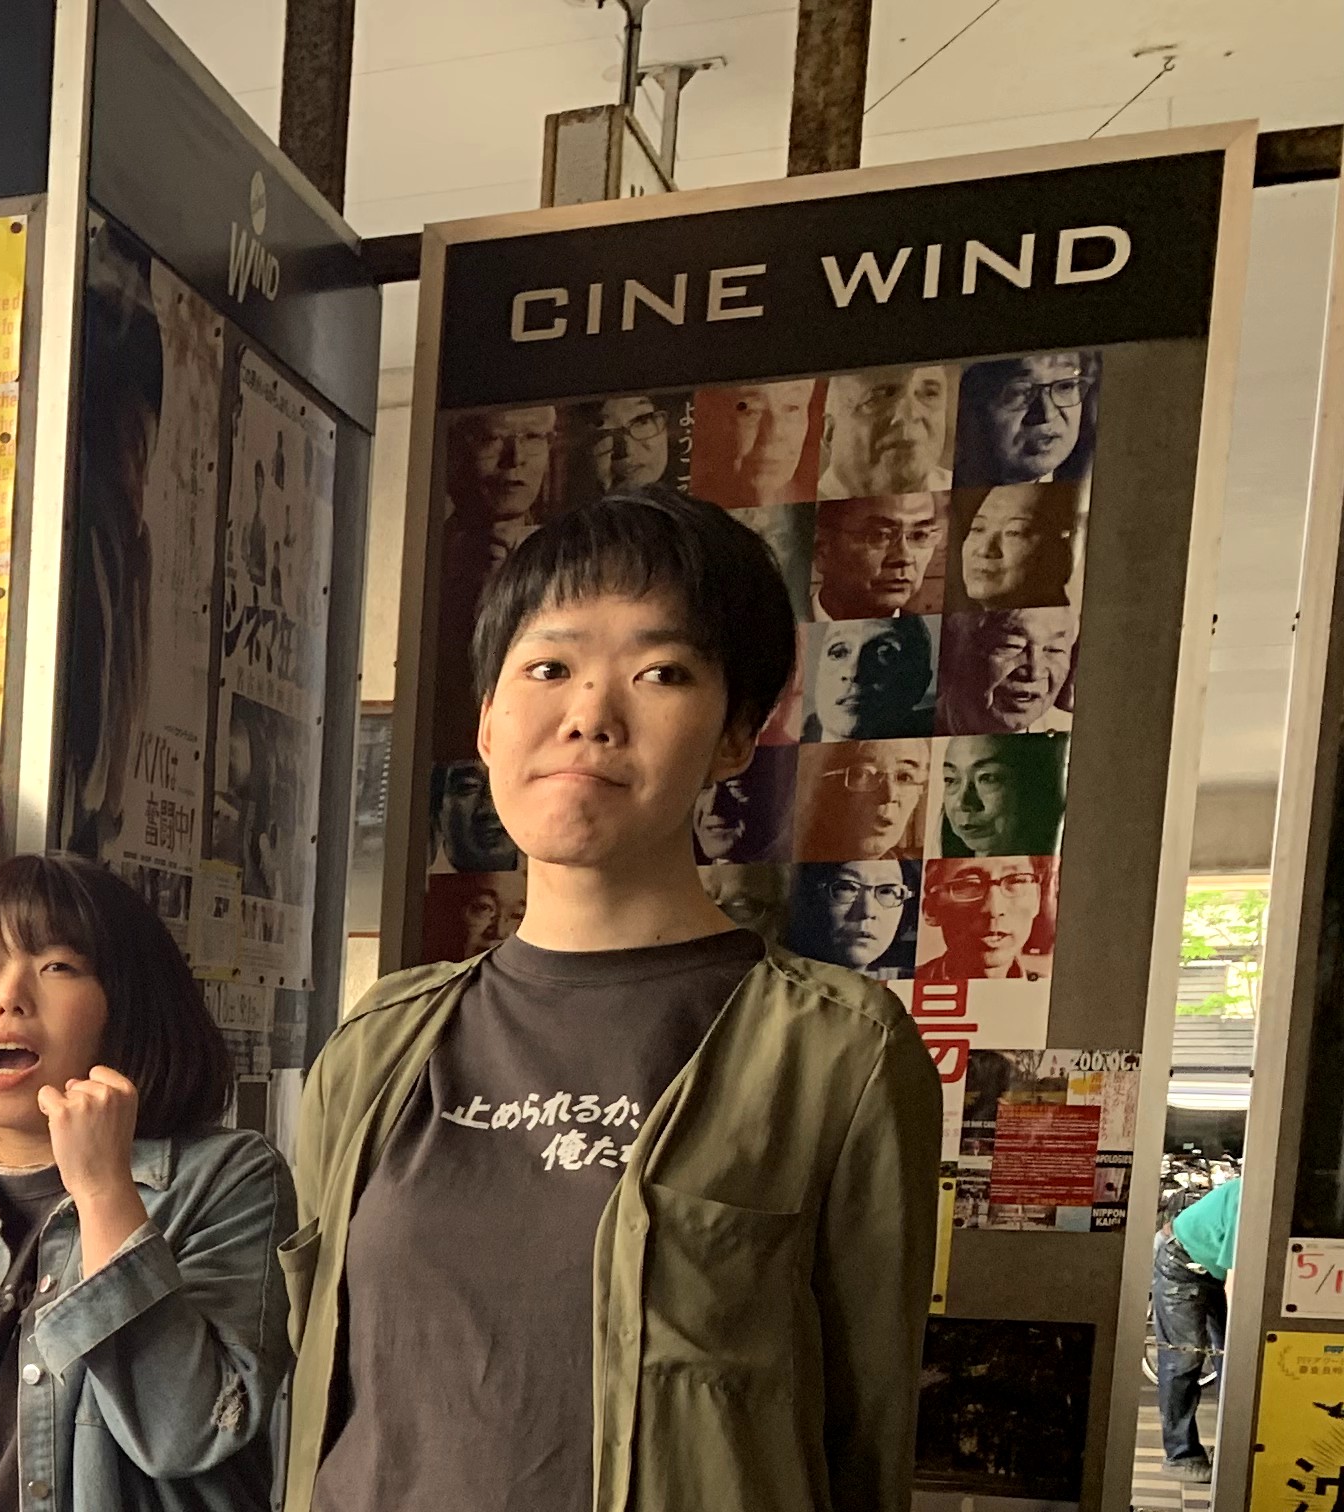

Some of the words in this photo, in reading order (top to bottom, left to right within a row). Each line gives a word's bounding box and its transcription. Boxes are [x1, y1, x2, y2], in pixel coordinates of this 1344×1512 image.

[228, 221, 281, 303] WIND
[511, 262, 768, 344] CINE
[820, 224, 1133, 309] WIND
[1092, 1208, 1126, 1219] NIPPON
